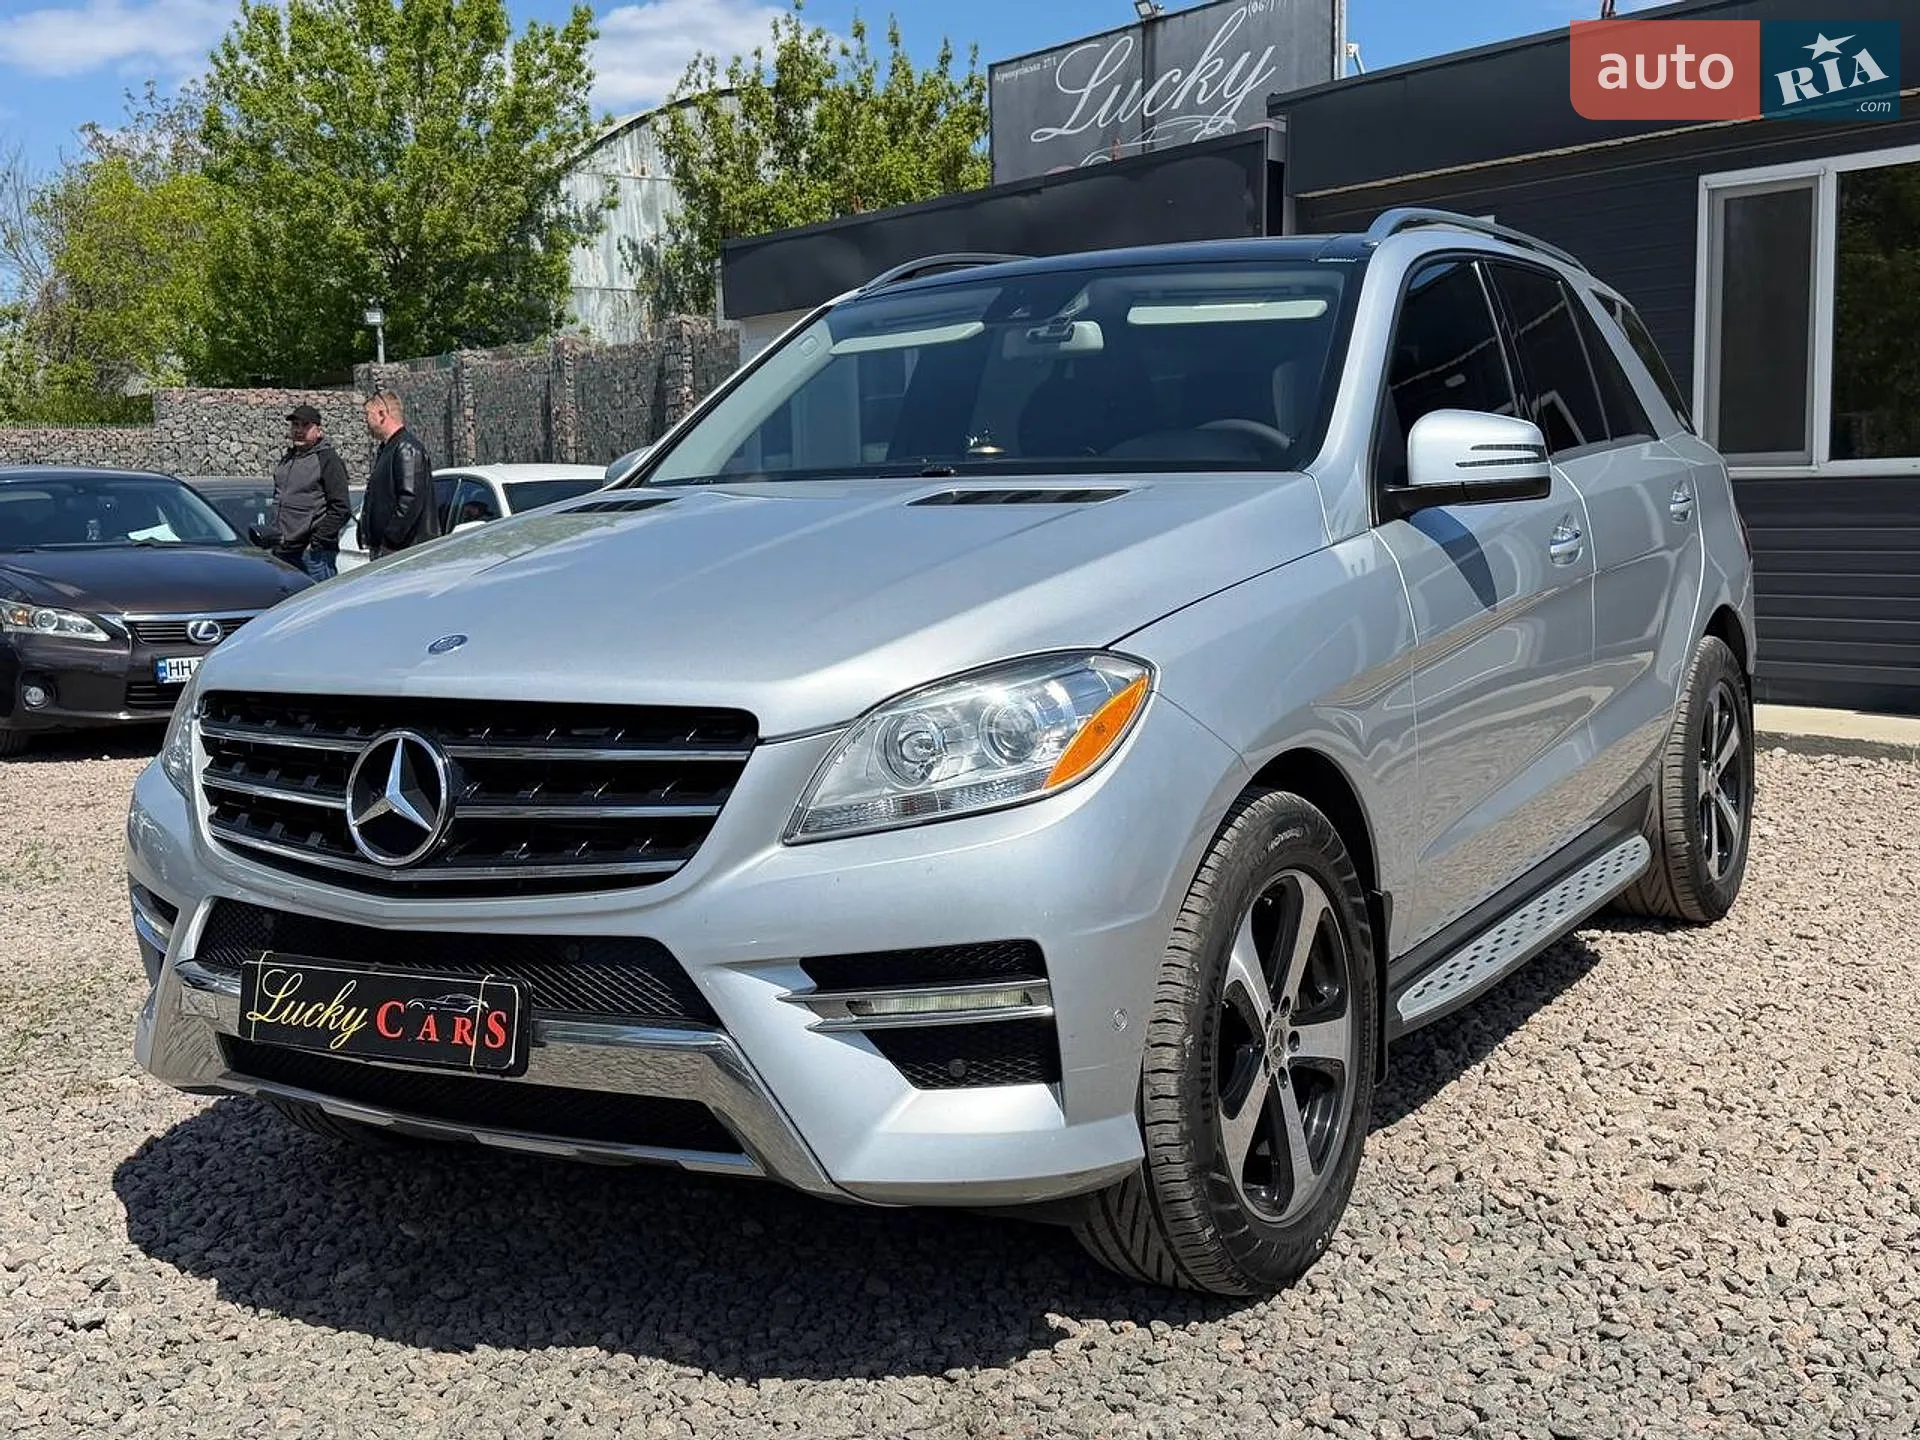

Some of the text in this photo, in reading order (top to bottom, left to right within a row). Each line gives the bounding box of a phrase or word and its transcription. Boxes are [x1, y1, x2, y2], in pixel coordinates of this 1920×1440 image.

[1031, 6, 1276, 143] Lucky
[246, 968, 508, 1050] Lucky CARS
